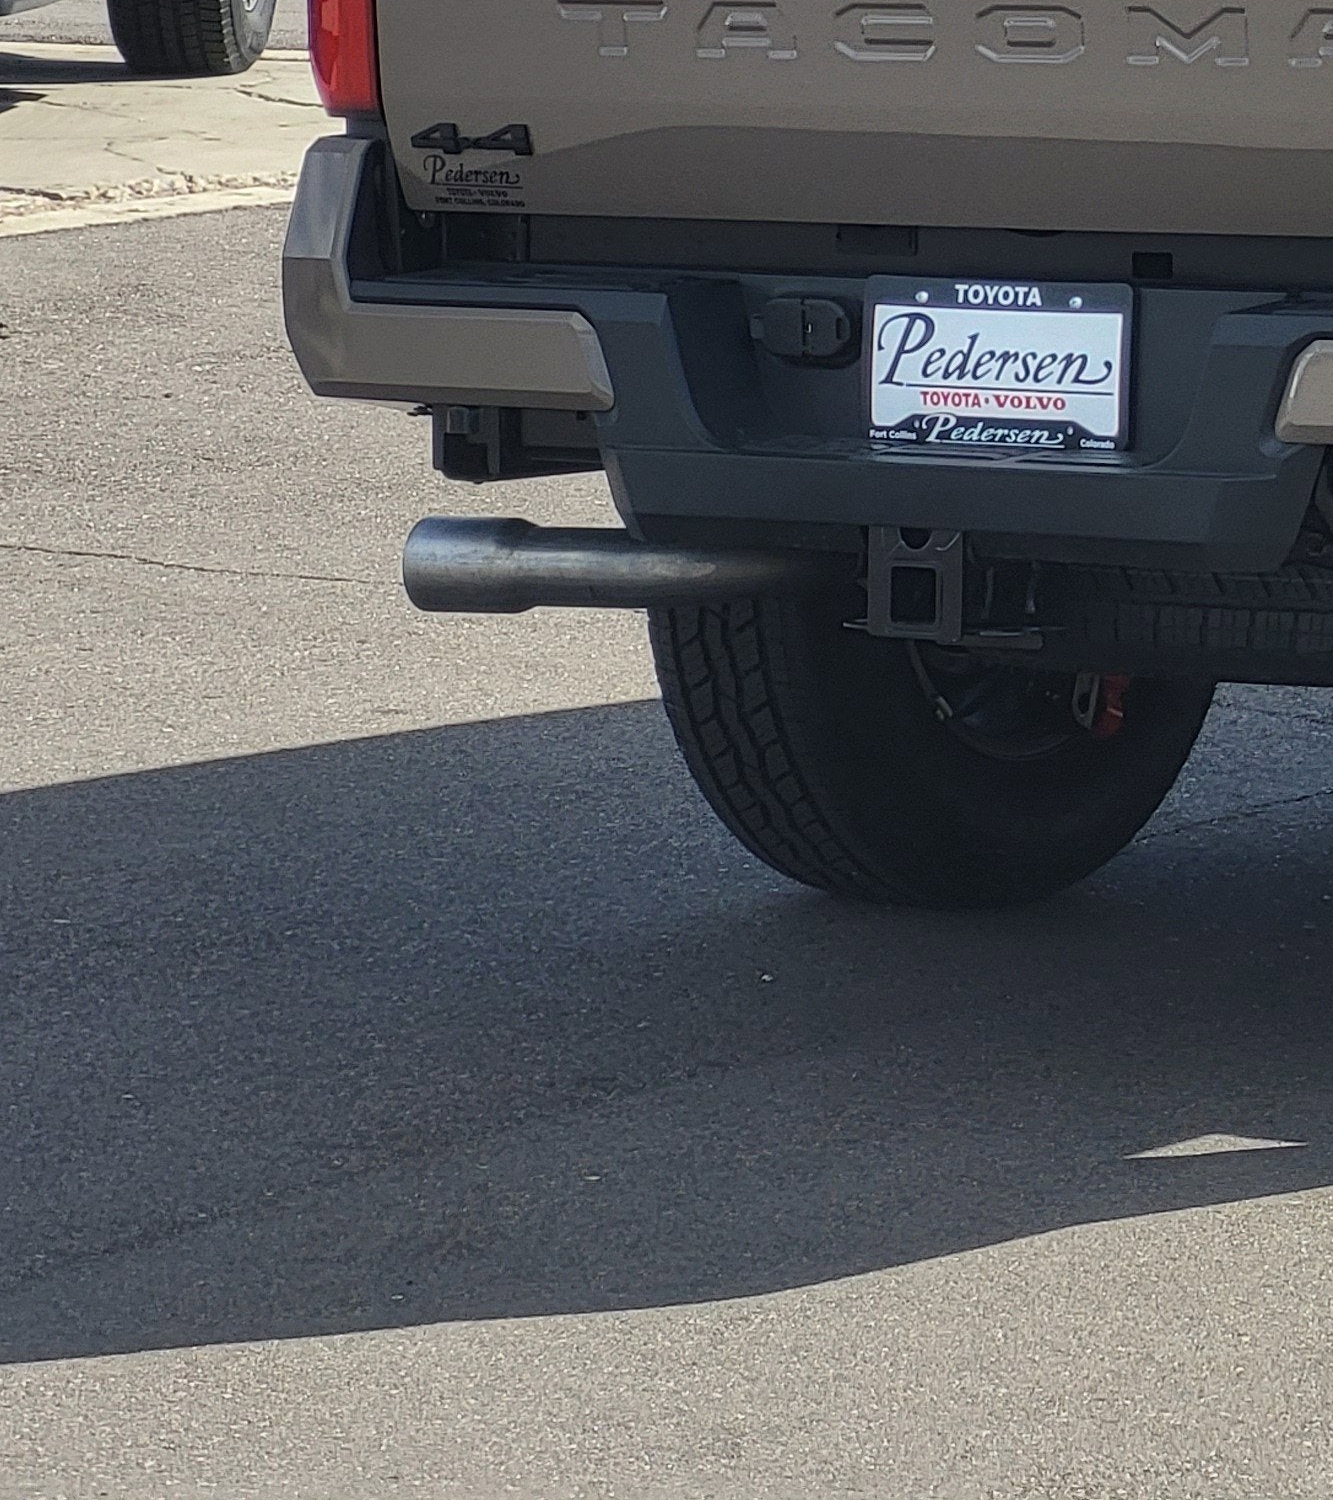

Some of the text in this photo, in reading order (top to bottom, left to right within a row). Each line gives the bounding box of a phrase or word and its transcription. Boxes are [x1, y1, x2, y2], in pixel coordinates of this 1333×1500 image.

[423, 155, 520, 184] Pedersen
[954, 284, 1042, 306] TOYOTA
[877, 312, 1113, 386] Pedersen
[920, 391, 1066, 411] TOYOTA VOLVO
[869, 429, 888, 439] Fort
[921, 412, 1064, 445] Pedersen
